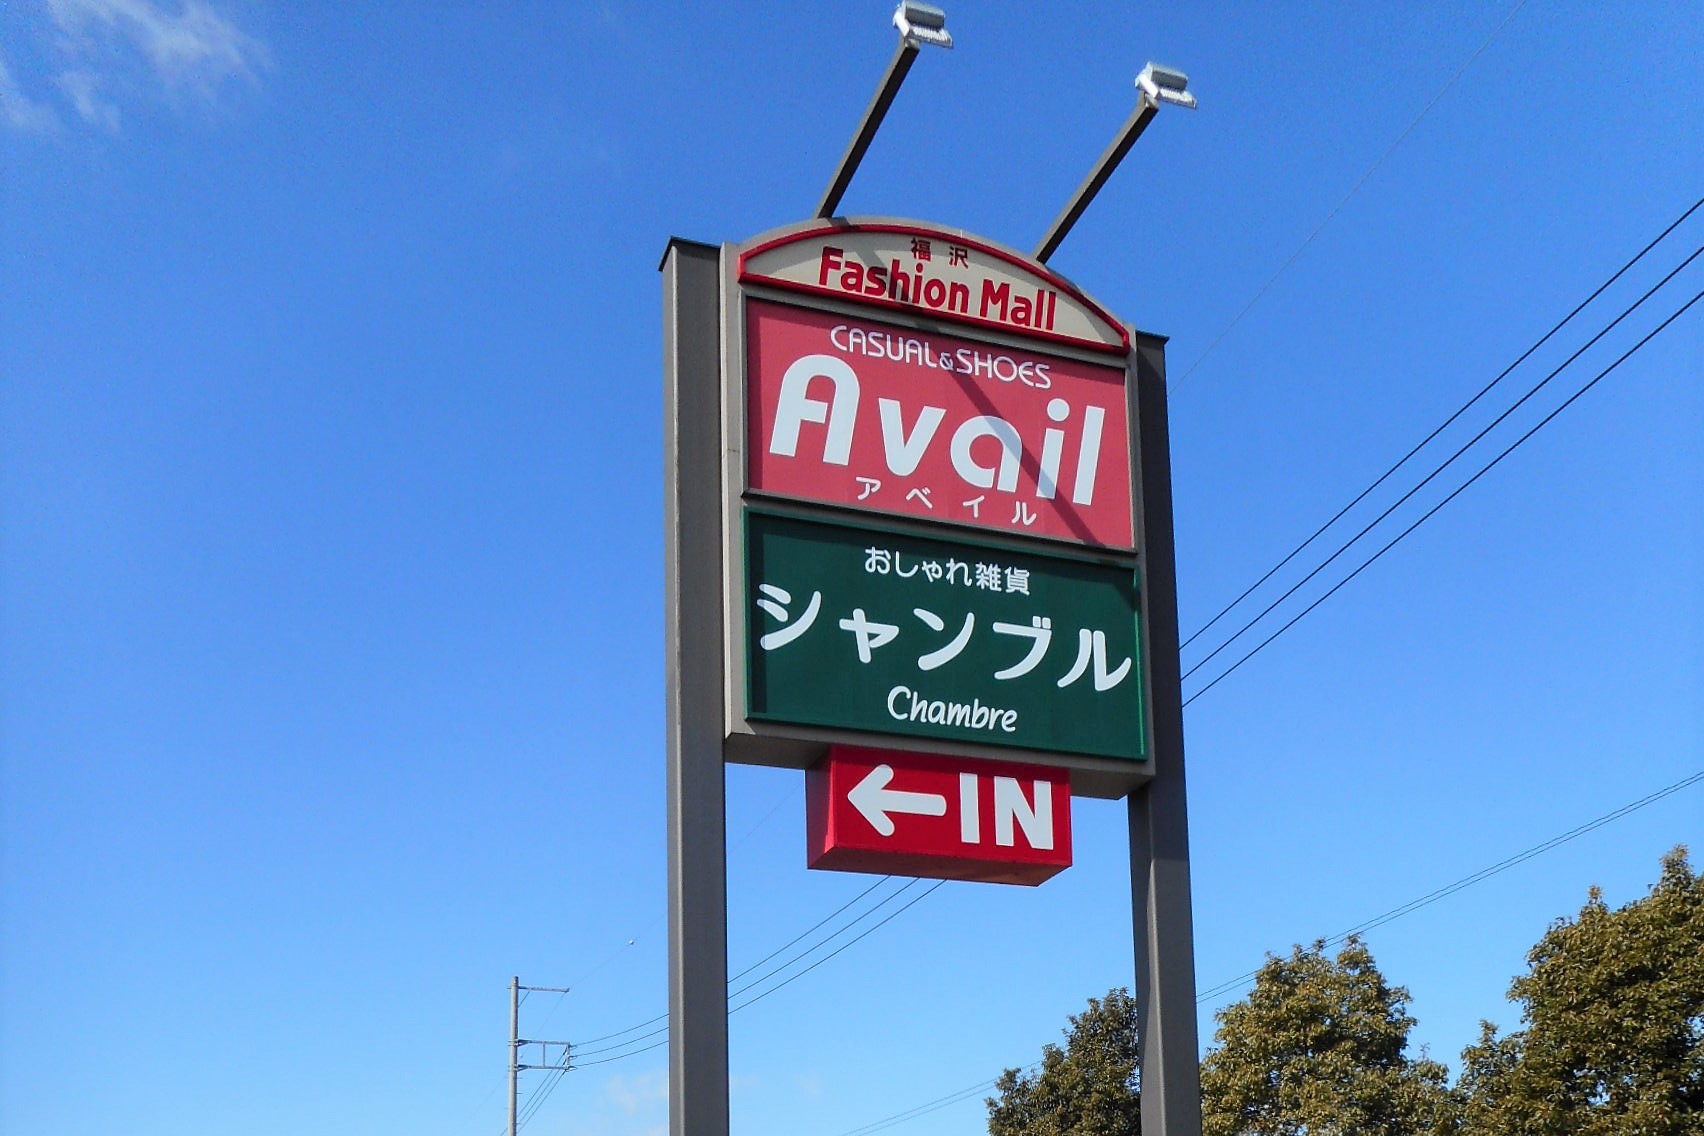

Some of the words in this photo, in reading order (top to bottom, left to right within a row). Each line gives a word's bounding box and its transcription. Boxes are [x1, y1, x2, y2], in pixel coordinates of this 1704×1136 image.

[910, 237, 969, 269] 福沢
[818, 246, 970, 314] Fashion
[979, 278, 1056, 331] Mall
[769, 354, 1105, 506] Avail
[856, 476, 1037, 526] アベイル
[865, 546, 1030, 596] おしゃれ雑貨
[757, 583, 1132, 692] シャンブル
[887, 685, 1018, 732] Chambre
[959, 772, 1054, 850] IN
